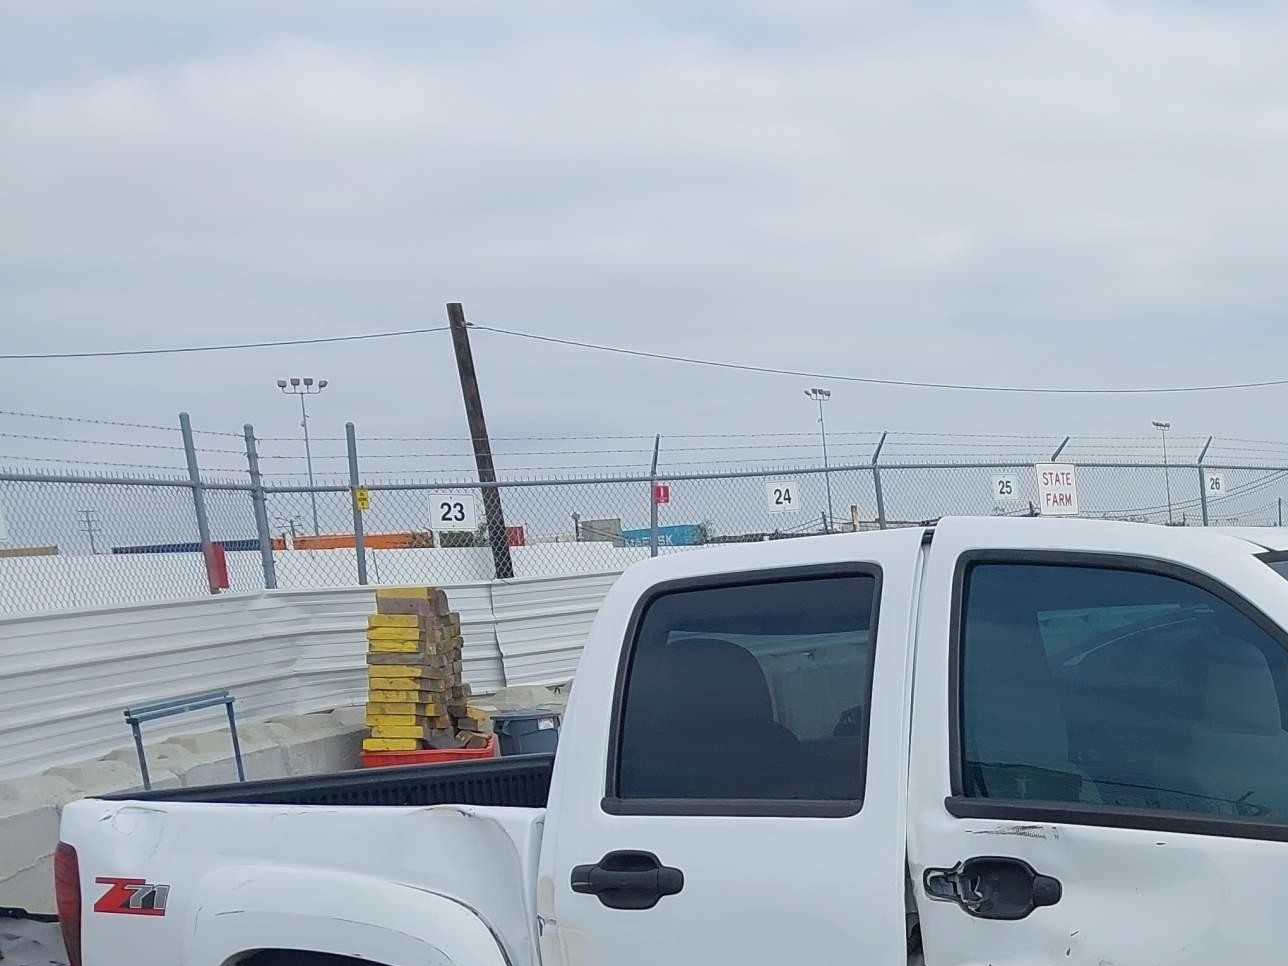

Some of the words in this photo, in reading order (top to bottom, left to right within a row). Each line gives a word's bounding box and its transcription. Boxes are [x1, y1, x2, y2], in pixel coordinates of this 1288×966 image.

[1042, 472, 1072, 486] STATE
[1210, 477, 1220, 490] 26
[998, 480, 1012, 495] 25
[773, 488, 792, 505] 24
[1046, 493, 1073, 506] FARM
[440, 502, 465, 521] 23
[94, 877, 170, 916] Z71
